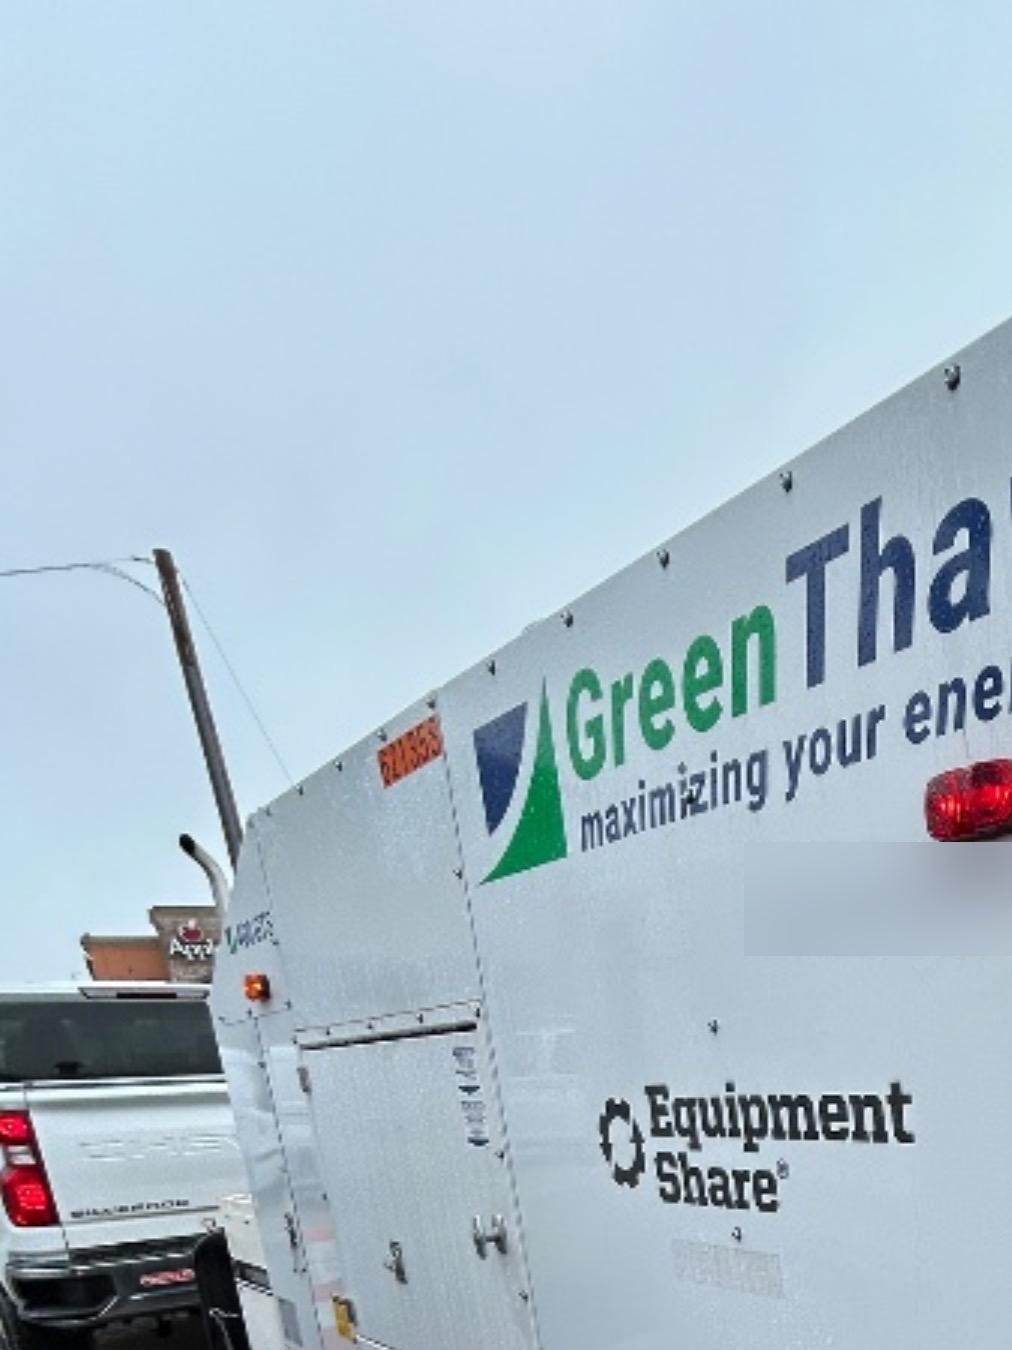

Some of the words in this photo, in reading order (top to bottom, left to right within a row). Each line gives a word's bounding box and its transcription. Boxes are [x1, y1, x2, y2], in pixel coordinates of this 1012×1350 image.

[580, 748, 768, 852] maximizing
[783, 703, 885, 800] your
[644, 1080, 916, 1152] Equipment
